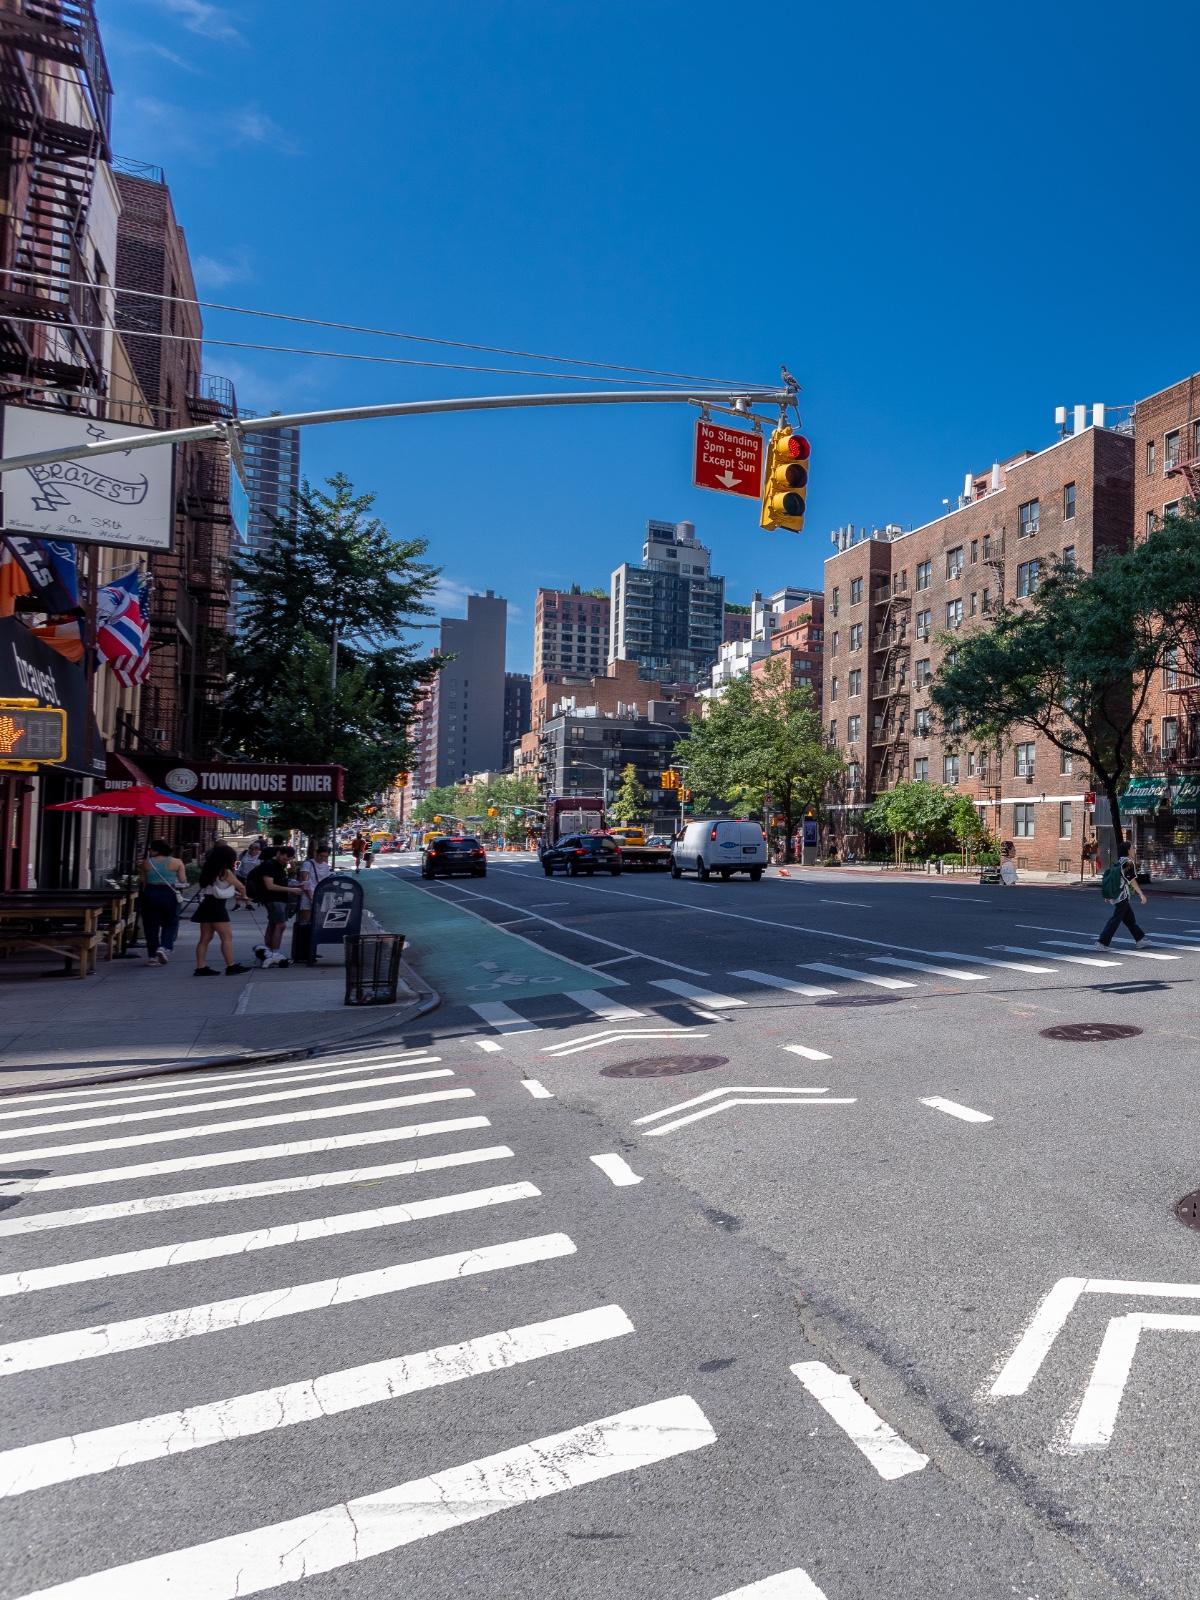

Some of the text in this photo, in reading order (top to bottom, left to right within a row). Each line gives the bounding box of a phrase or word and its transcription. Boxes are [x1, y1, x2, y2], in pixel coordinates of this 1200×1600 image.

[701, 426, 759, 451] No Standing
[703, 441, 725, 454] 3pm
[735, 448, 756, 461] 8pm
[702, 452, 756, 473] Except Sun
[33, 463, 142, 501] BRAVEST
[12, 642, 61, 706] bravest
[104, 780, 133, 790] DINER
[200, 772, 286, 792] TOWNHOUSE
[292, 775, 332, 792] DINER
[1125, 785, 1167, 797] Lumber
